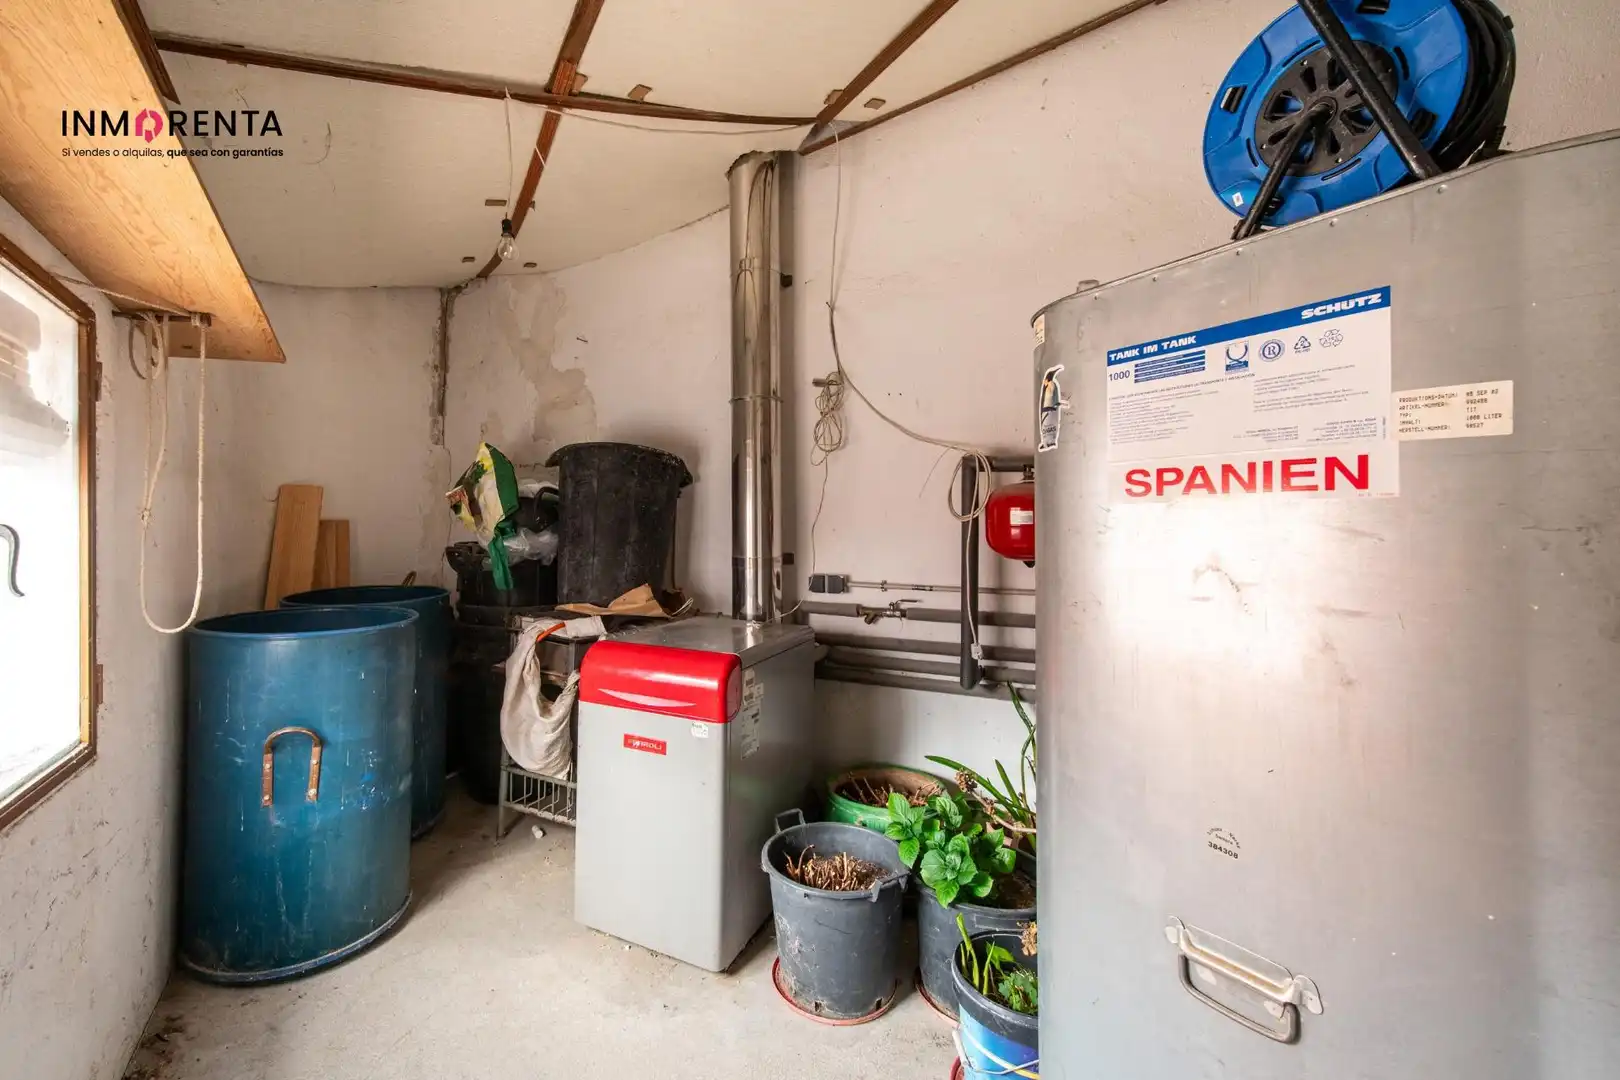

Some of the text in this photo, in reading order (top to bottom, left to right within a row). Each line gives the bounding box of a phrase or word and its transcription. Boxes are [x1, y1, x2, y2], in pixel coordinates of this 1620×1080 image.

[1109, 335, 1197, 361] TANK IM TANK
[1108, 369, 1130, 382] 1000
[1125, 455, 1369, 498] SPANIEN
[1207, 841, 1239, 859] 384308
